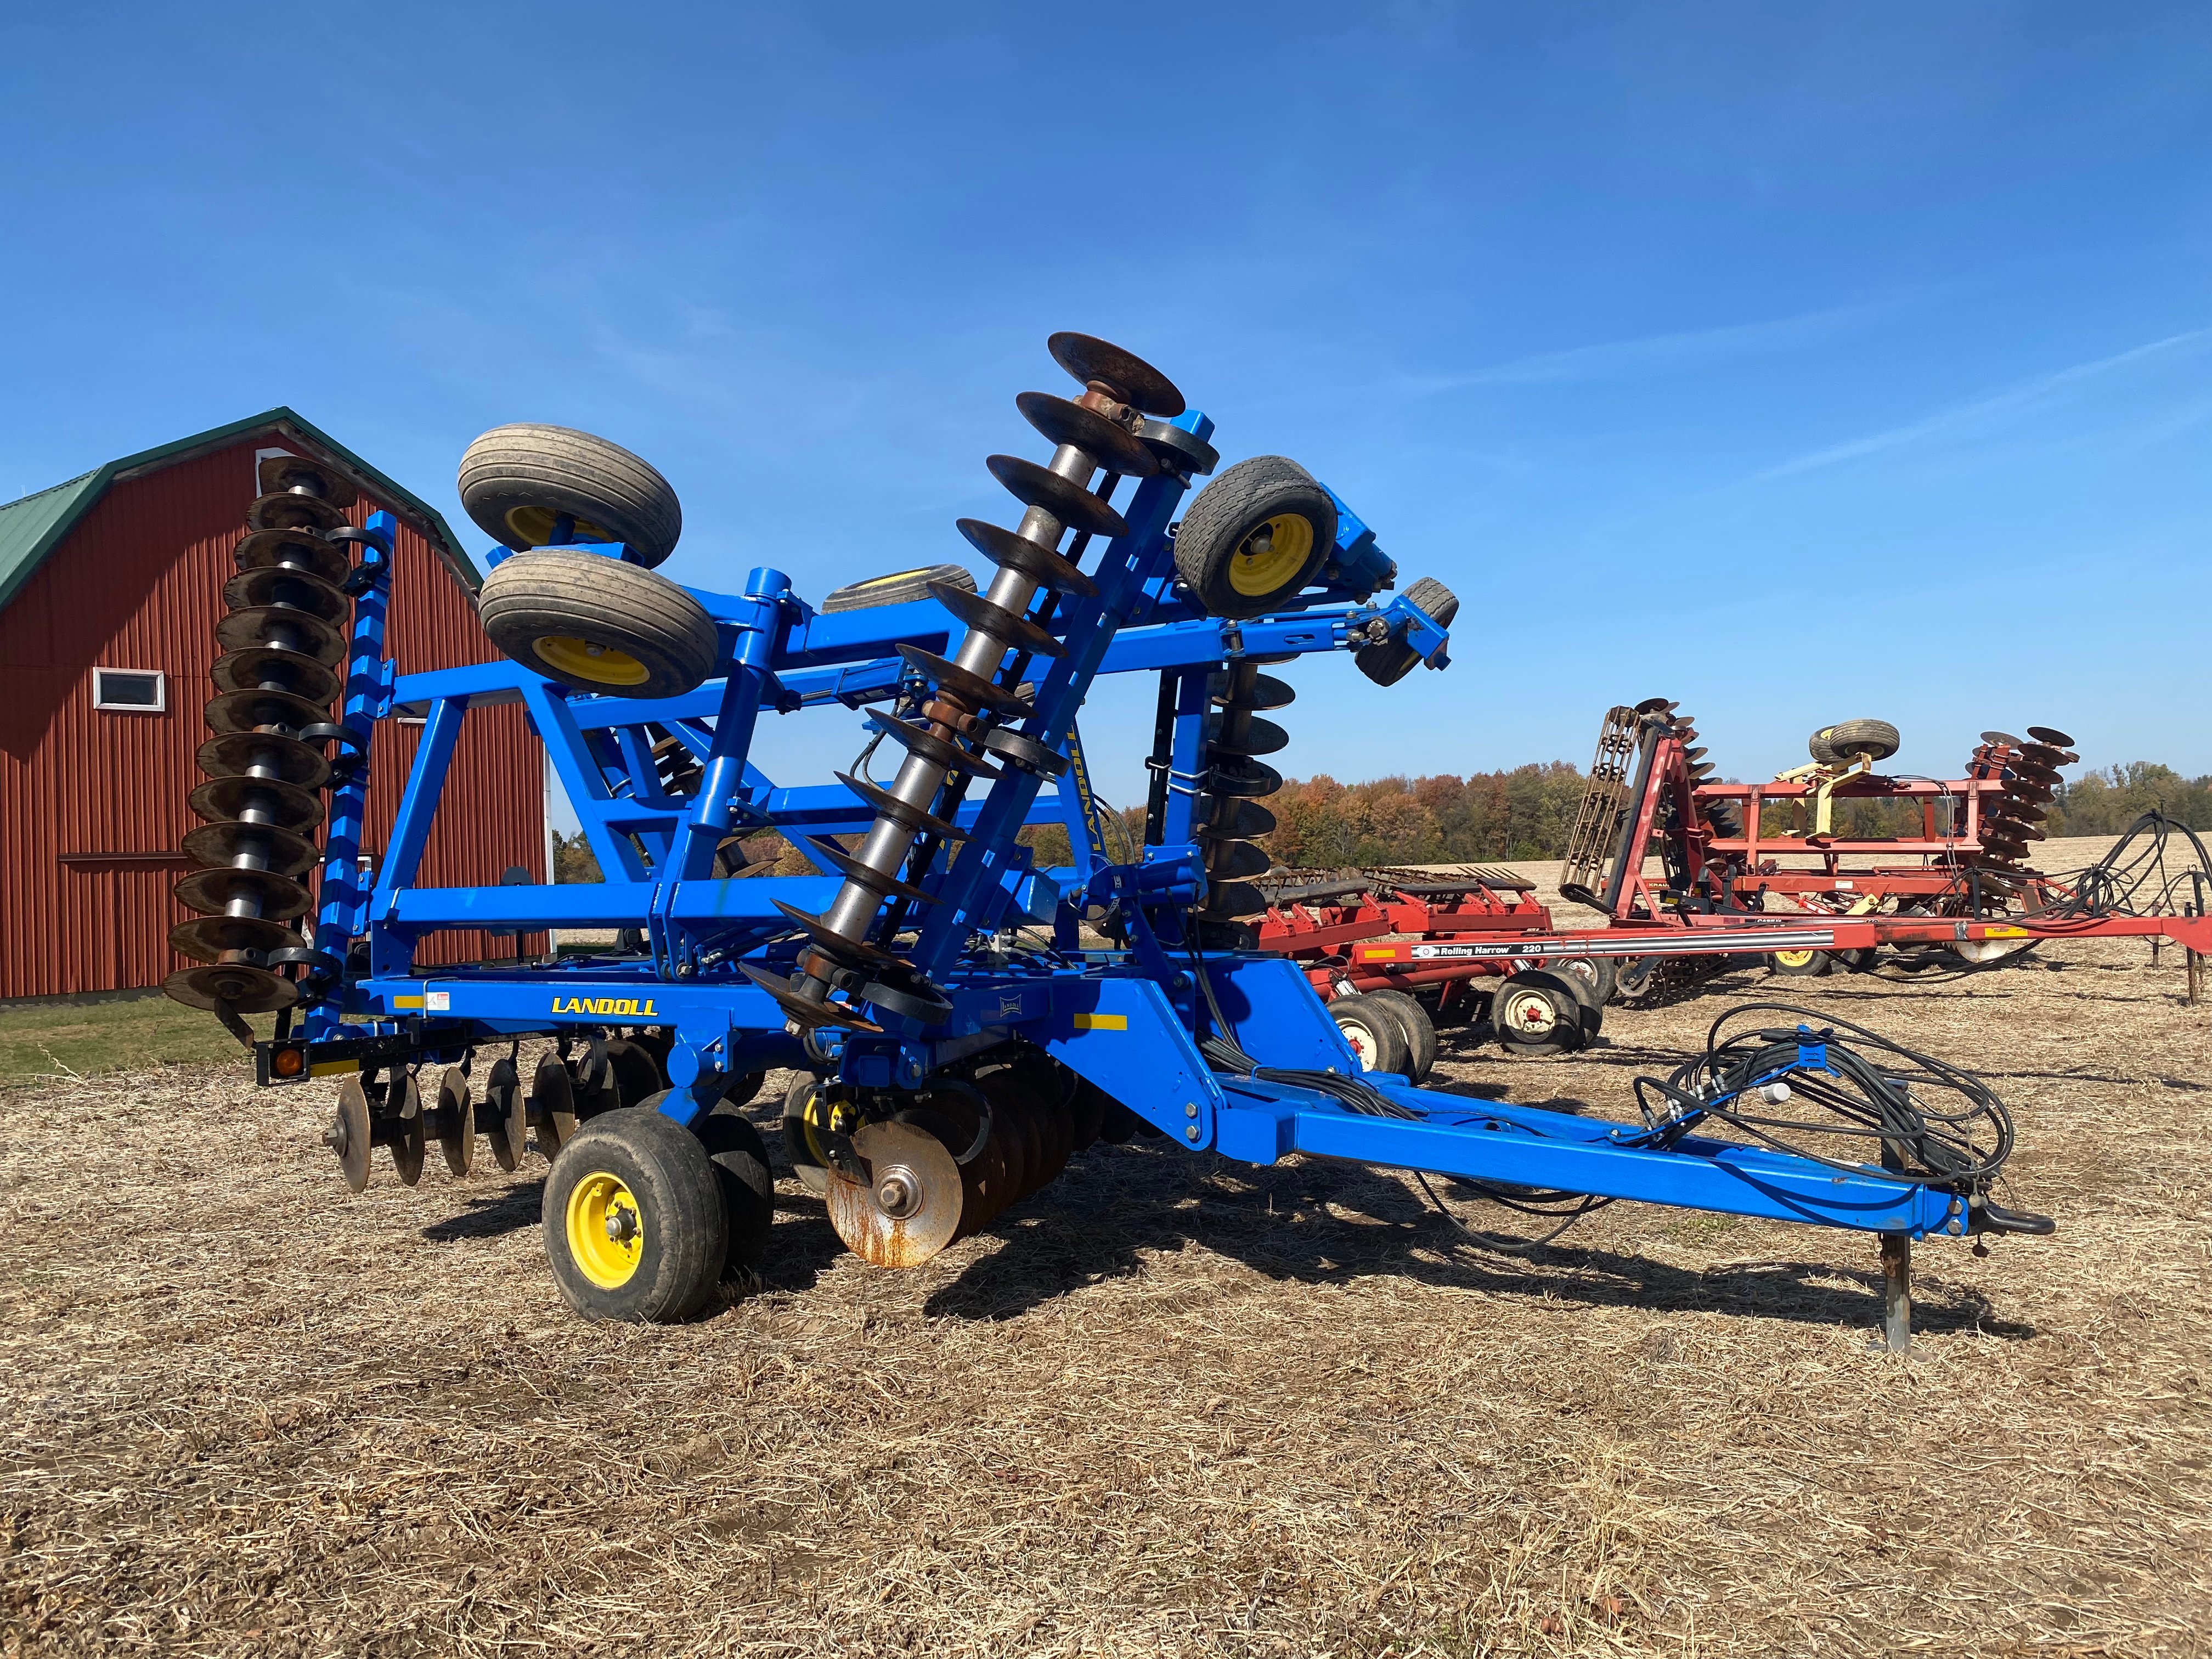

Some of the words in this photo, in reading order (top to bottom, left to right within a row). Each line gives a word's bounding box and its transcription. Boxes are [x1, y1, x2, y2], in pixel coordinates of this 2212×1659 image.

[1066, 724, 1102, 851] LANDOLL
[1441, 947, 1472, 956] Rolling
[551, 997, 659, 1017] LANDOLL
